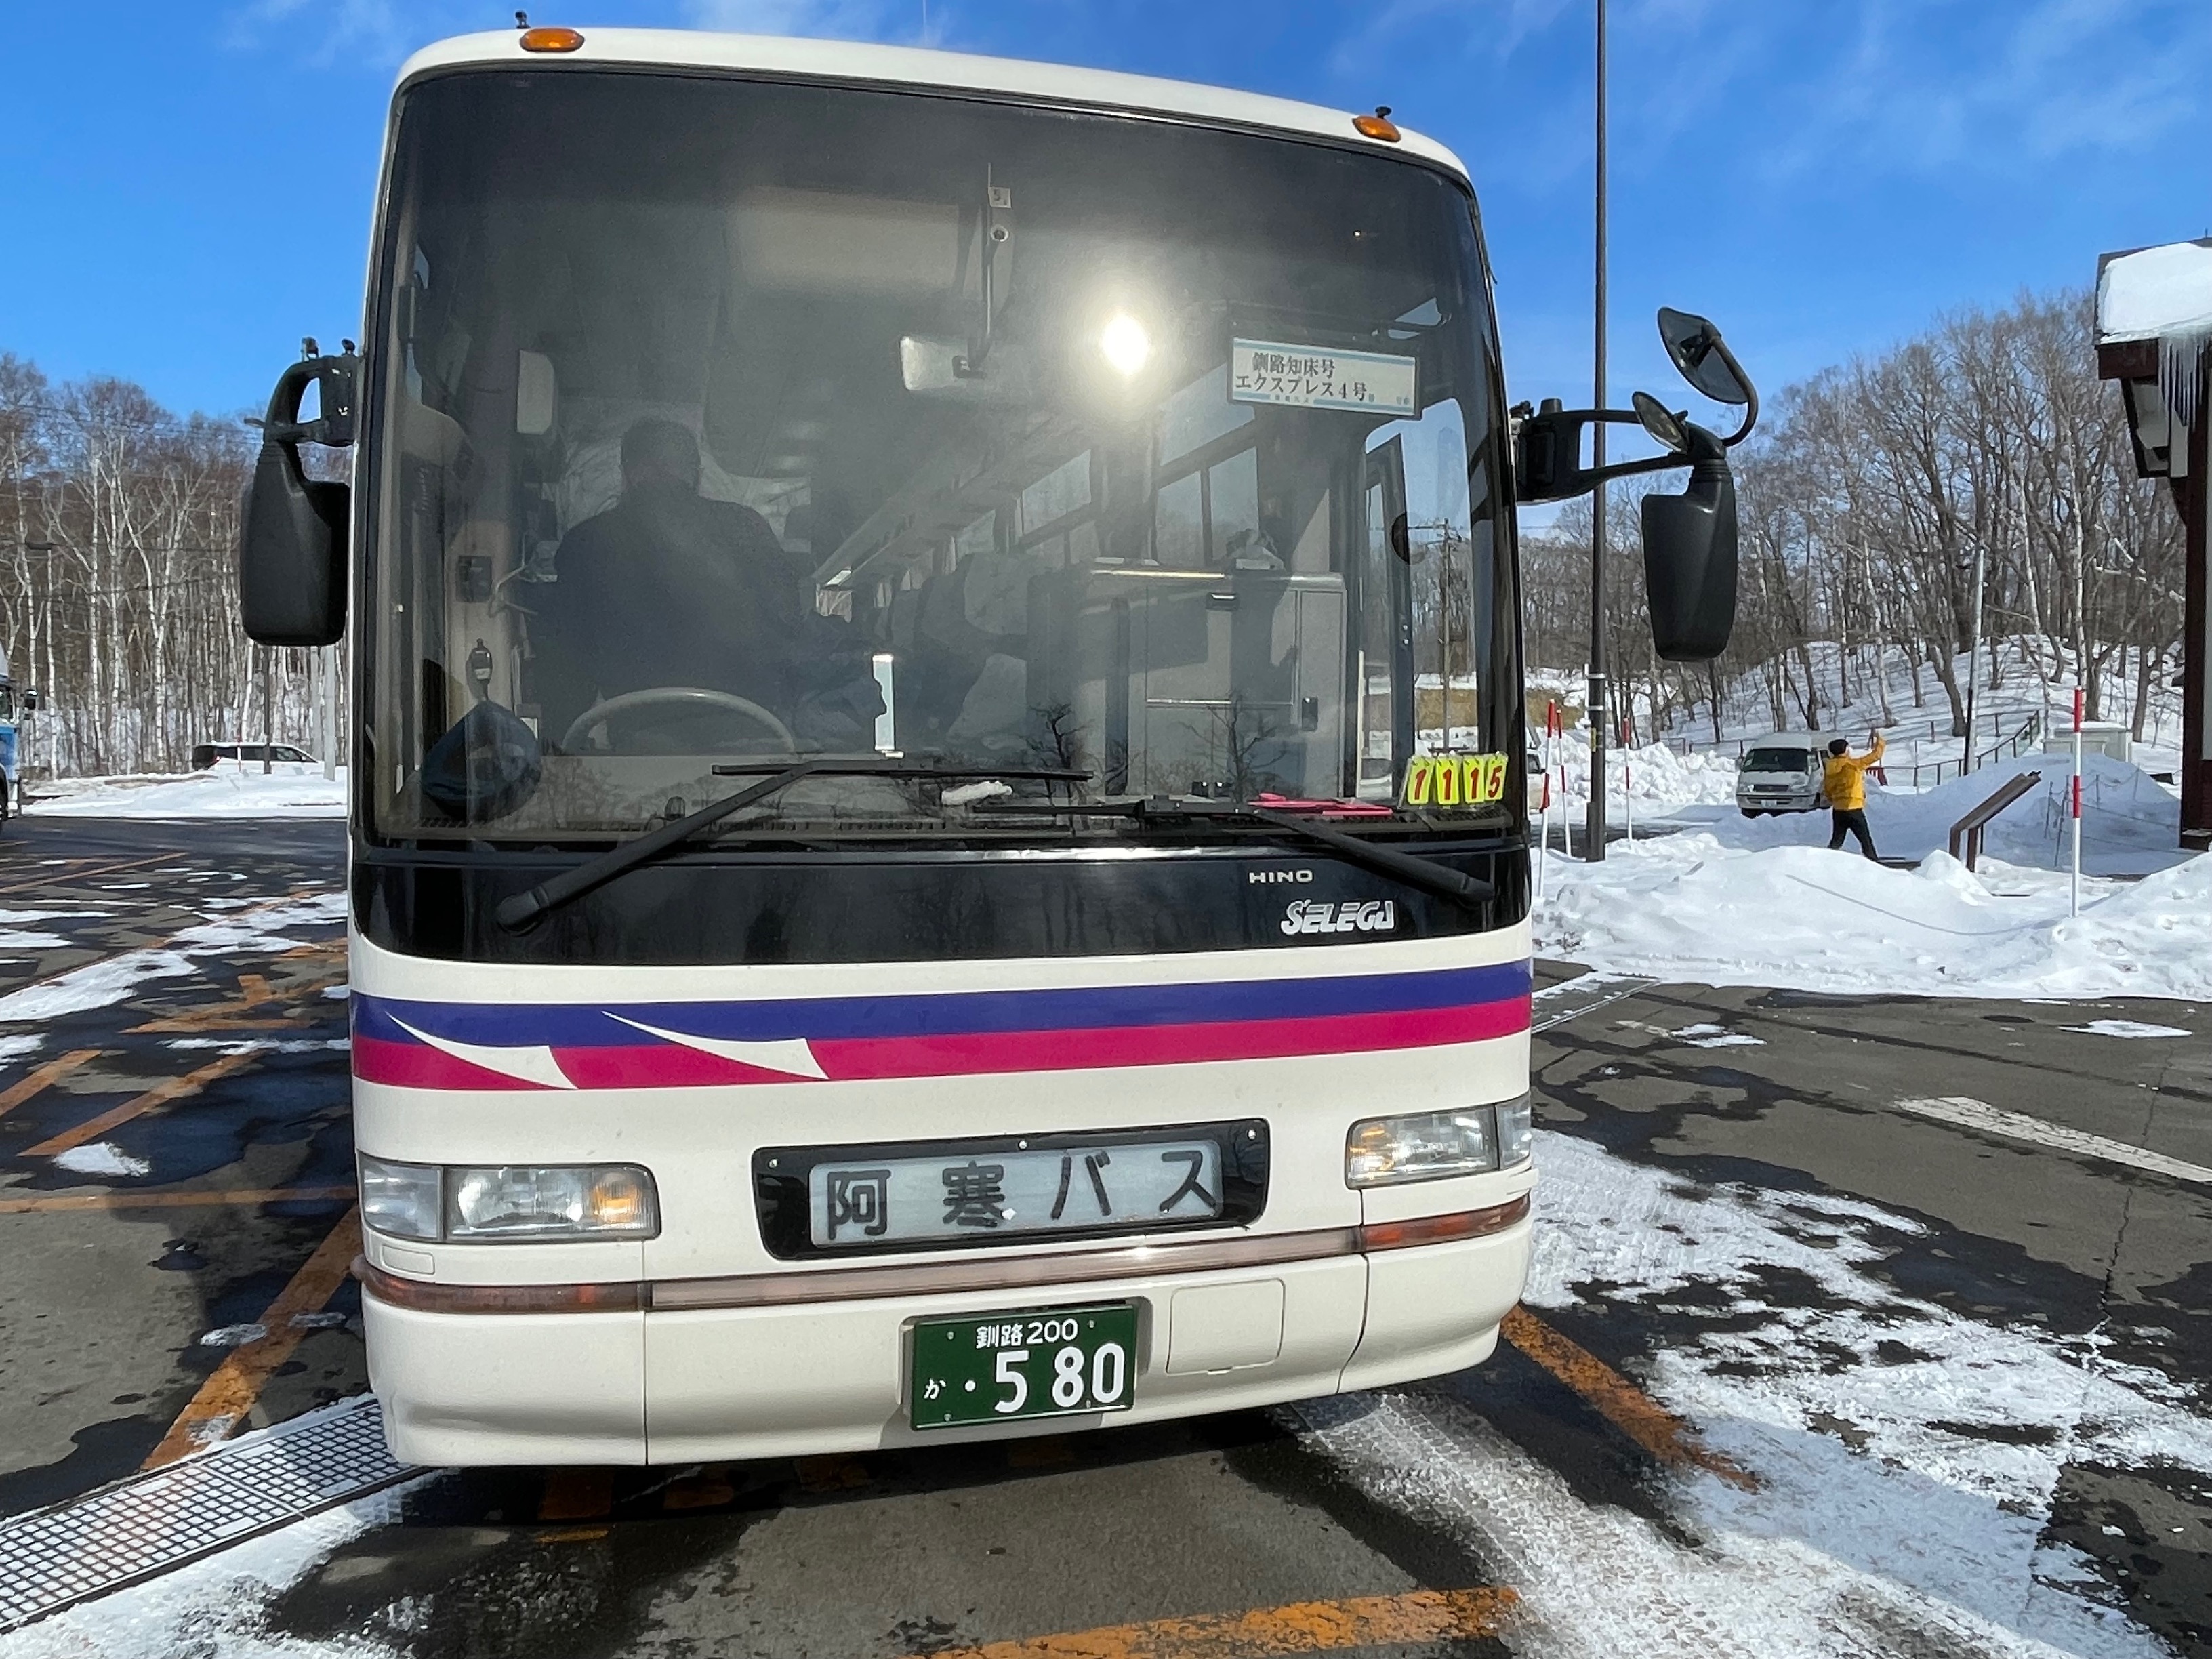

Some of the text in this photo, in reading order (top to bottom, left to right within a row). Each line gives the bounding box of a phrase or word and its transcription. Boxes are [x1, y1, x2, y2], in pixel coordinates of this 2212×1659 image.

[1252, 351, 1335, 379] 釧路知床号
[1248, 869, 1313, 884] HINO
